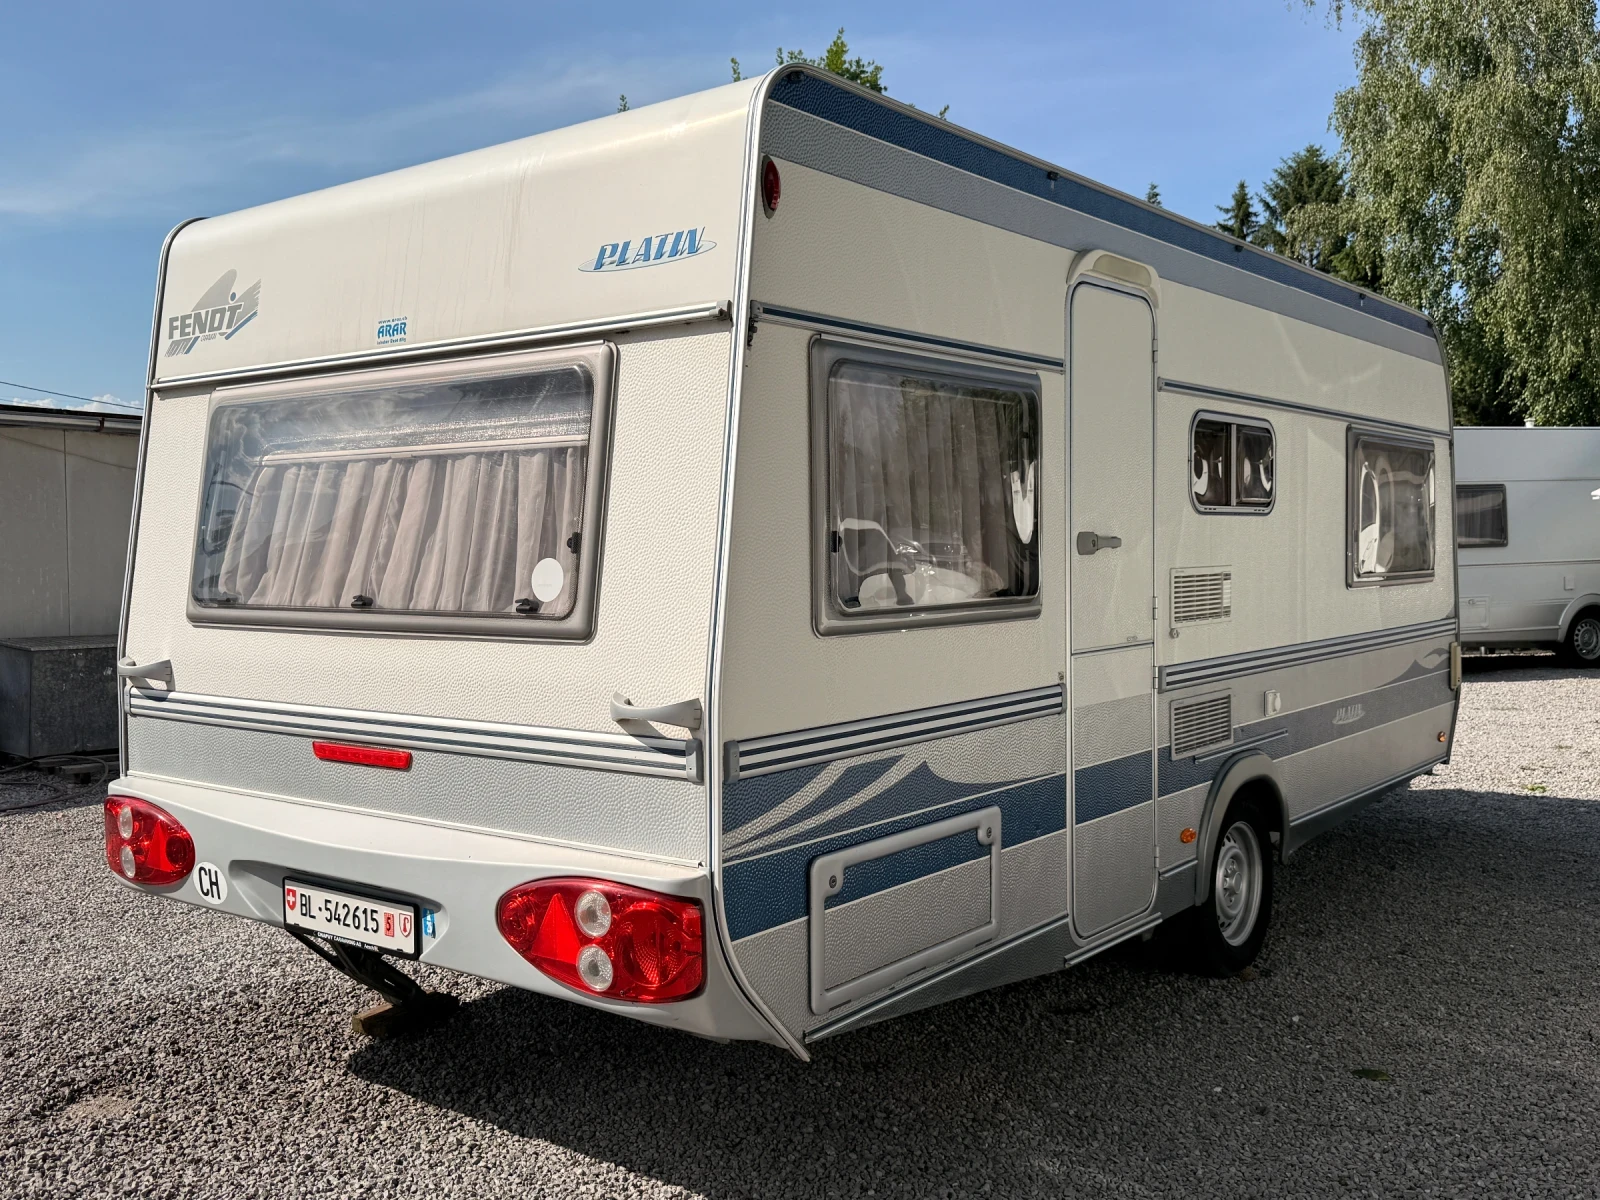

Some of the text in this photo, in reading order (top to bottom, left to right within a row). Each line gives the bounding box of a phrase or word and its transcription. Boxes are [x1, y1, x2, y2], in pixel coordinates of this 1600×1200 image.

[593, 226, 705, 271] PLATIN
[168, 303, 243, 340] FENDT
[377, 322, 407, 339] ARAR
[198, 866, 221, 900] CH
